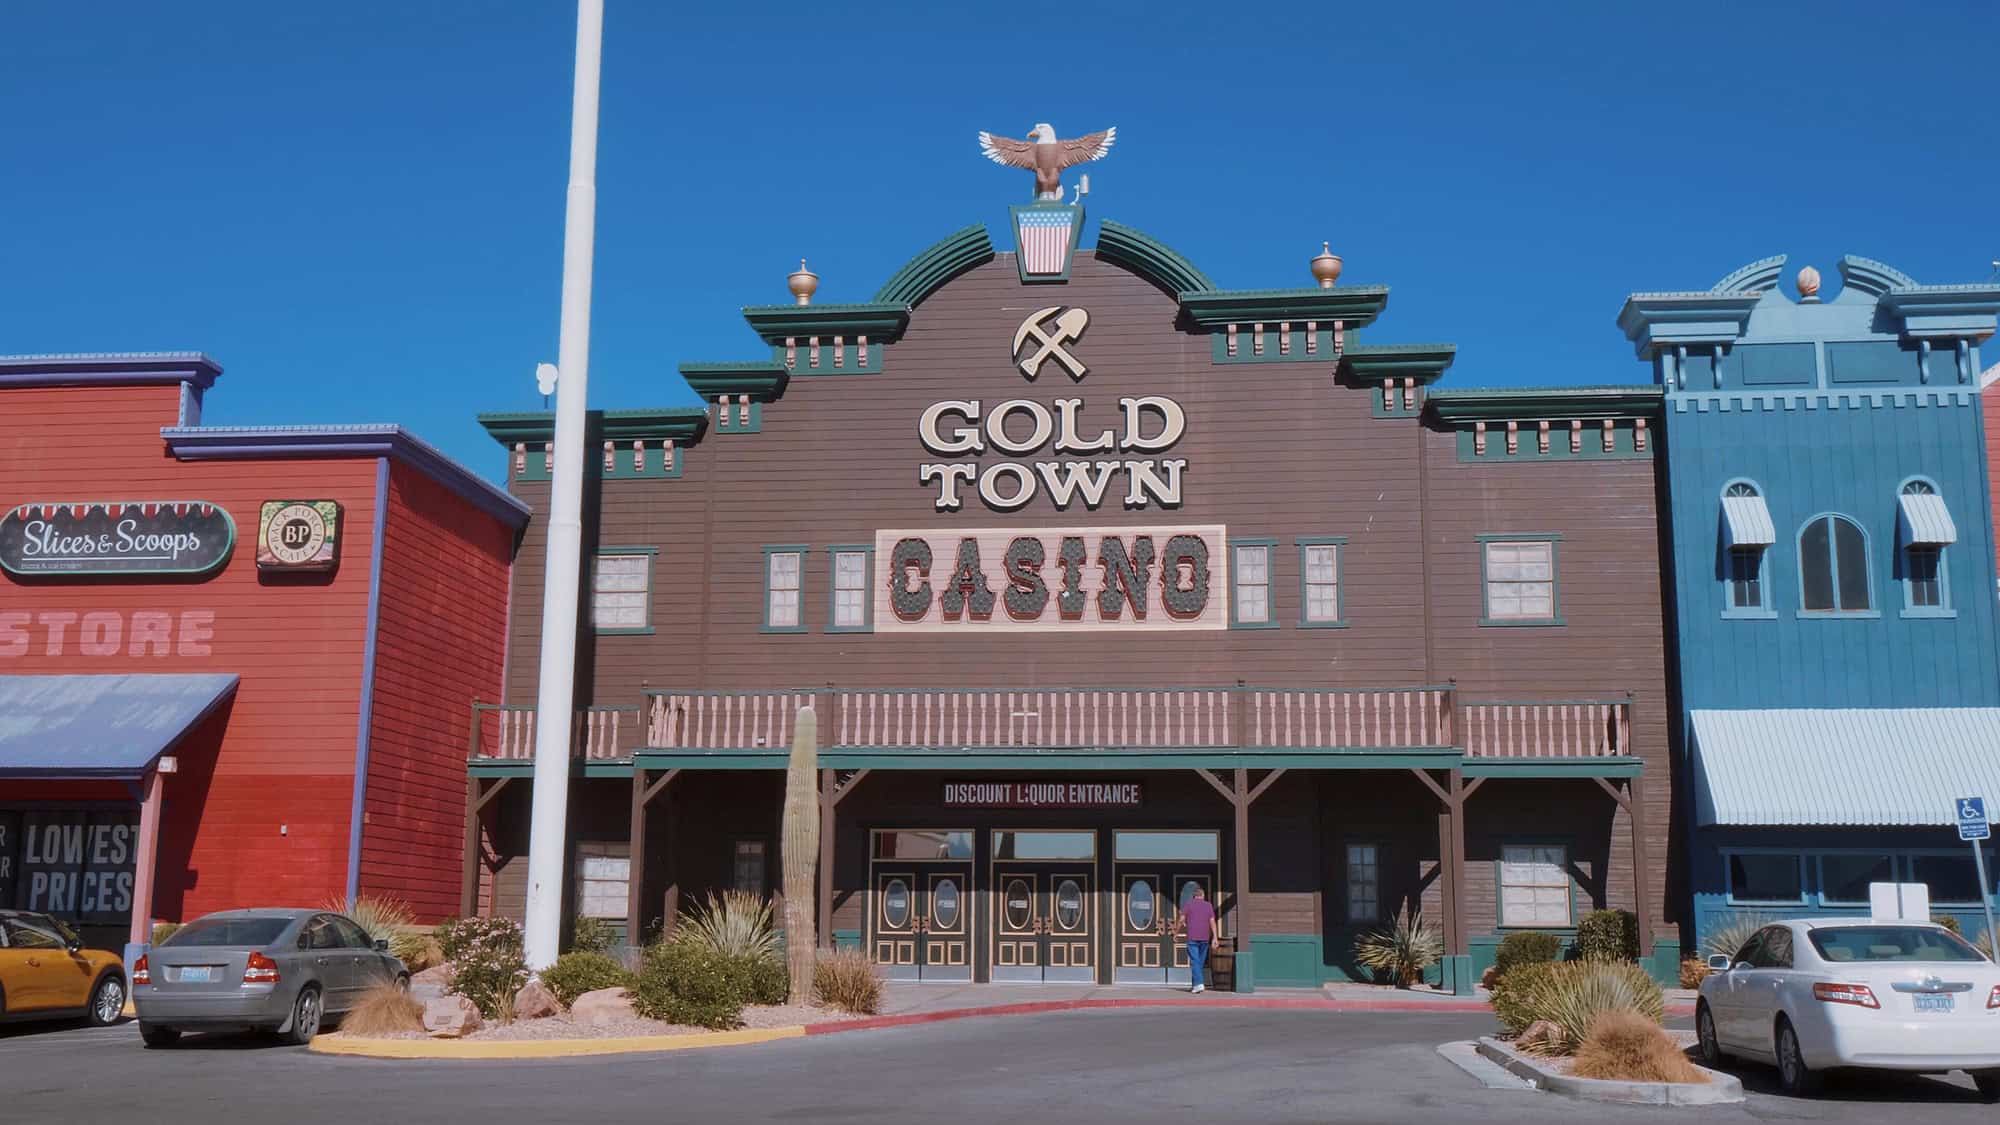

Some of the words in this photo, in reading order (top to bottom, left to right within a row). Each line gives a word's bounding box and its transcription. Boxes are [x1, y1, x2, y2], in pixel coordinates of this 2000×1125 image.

[919, 397, 1187, 455] GOLD
[919, 459, 1188, 512] TOWN
[23, 520, 99, 555] Slices
[97, 534, 113, 552] &
[116, 519, 200, 560] Scoops
[285, 526, 309, 543] BP
[887, 535, 1211, 621] CASINO
[0, 611, 215, 657] STORE
[945, 784, 1012, 803] DISCOUNT
[1069, 784, 1139, 804] ENTRANCE
[29, 871, 133, 912] PRICES
